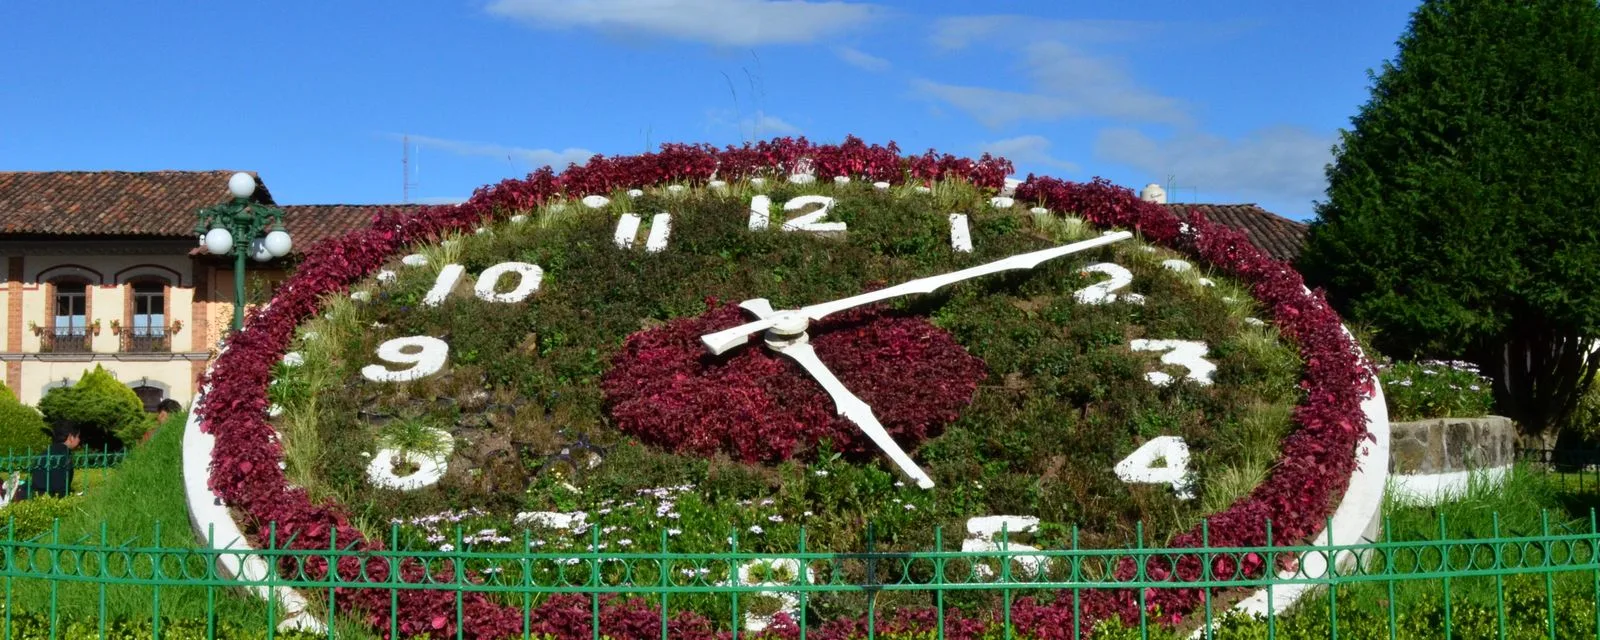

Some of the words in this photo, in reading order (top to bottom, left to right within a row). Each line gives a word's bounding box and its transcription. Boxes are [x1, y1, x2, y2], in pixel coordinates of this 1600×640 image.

[748, 195, 848, 231] 12
[949, 213, 974, 253] 1
[423, 261, 543, 307] 10
[1073, 262, 1146, 305] 2
[361, 335, 450, 382] 9
[1130, 339, 1218, 386] 3
[1114, 435, 1198, 500] 4
